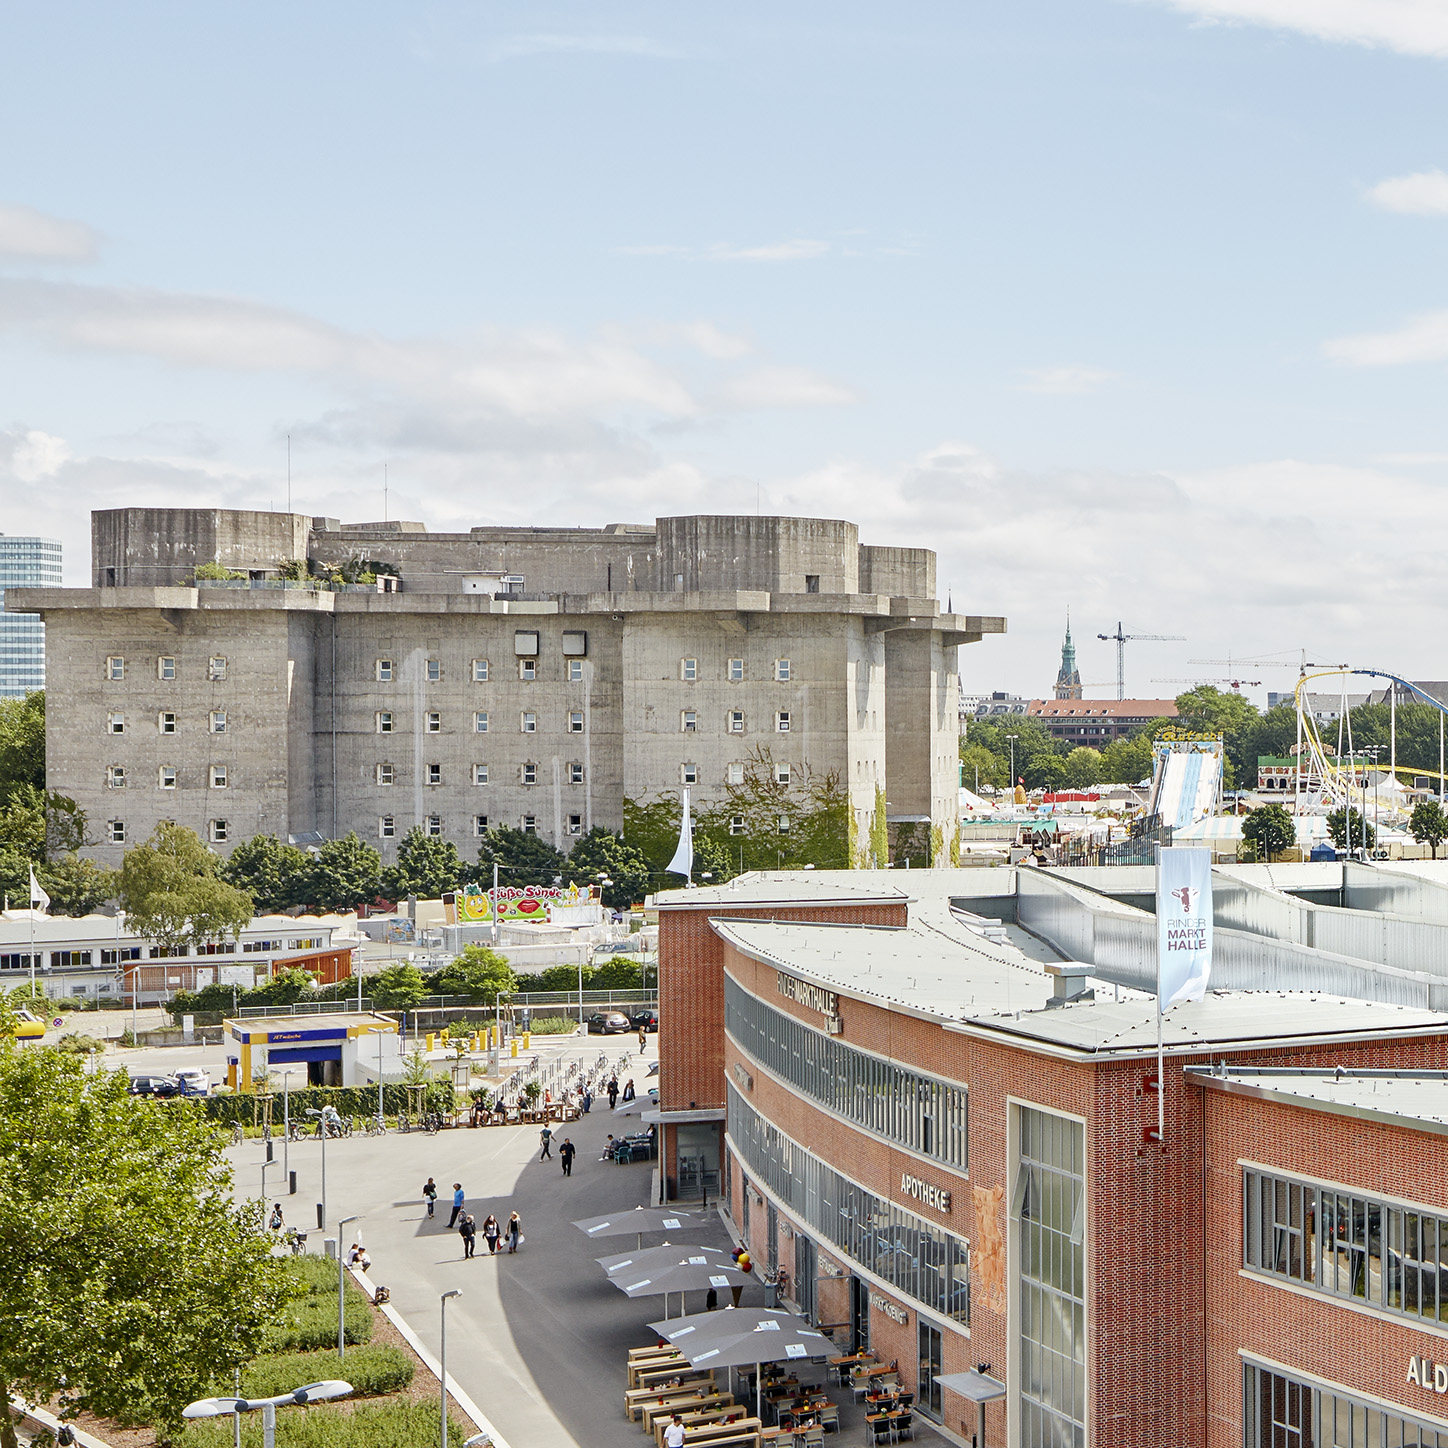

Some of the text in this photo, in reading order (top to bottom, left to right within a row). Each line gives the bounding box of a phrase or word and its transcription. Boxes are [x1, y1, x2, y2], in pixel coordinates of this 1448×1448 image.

[489, 886, 563, 900] Süße Sünde
[1167, 918, 1206, 928] RINDER
[1168, 929, 1206, 939] MARKT
[1168, 939, 1207, 951] HALLE
[901, 1173, 950, 1213] APOTHEKE
